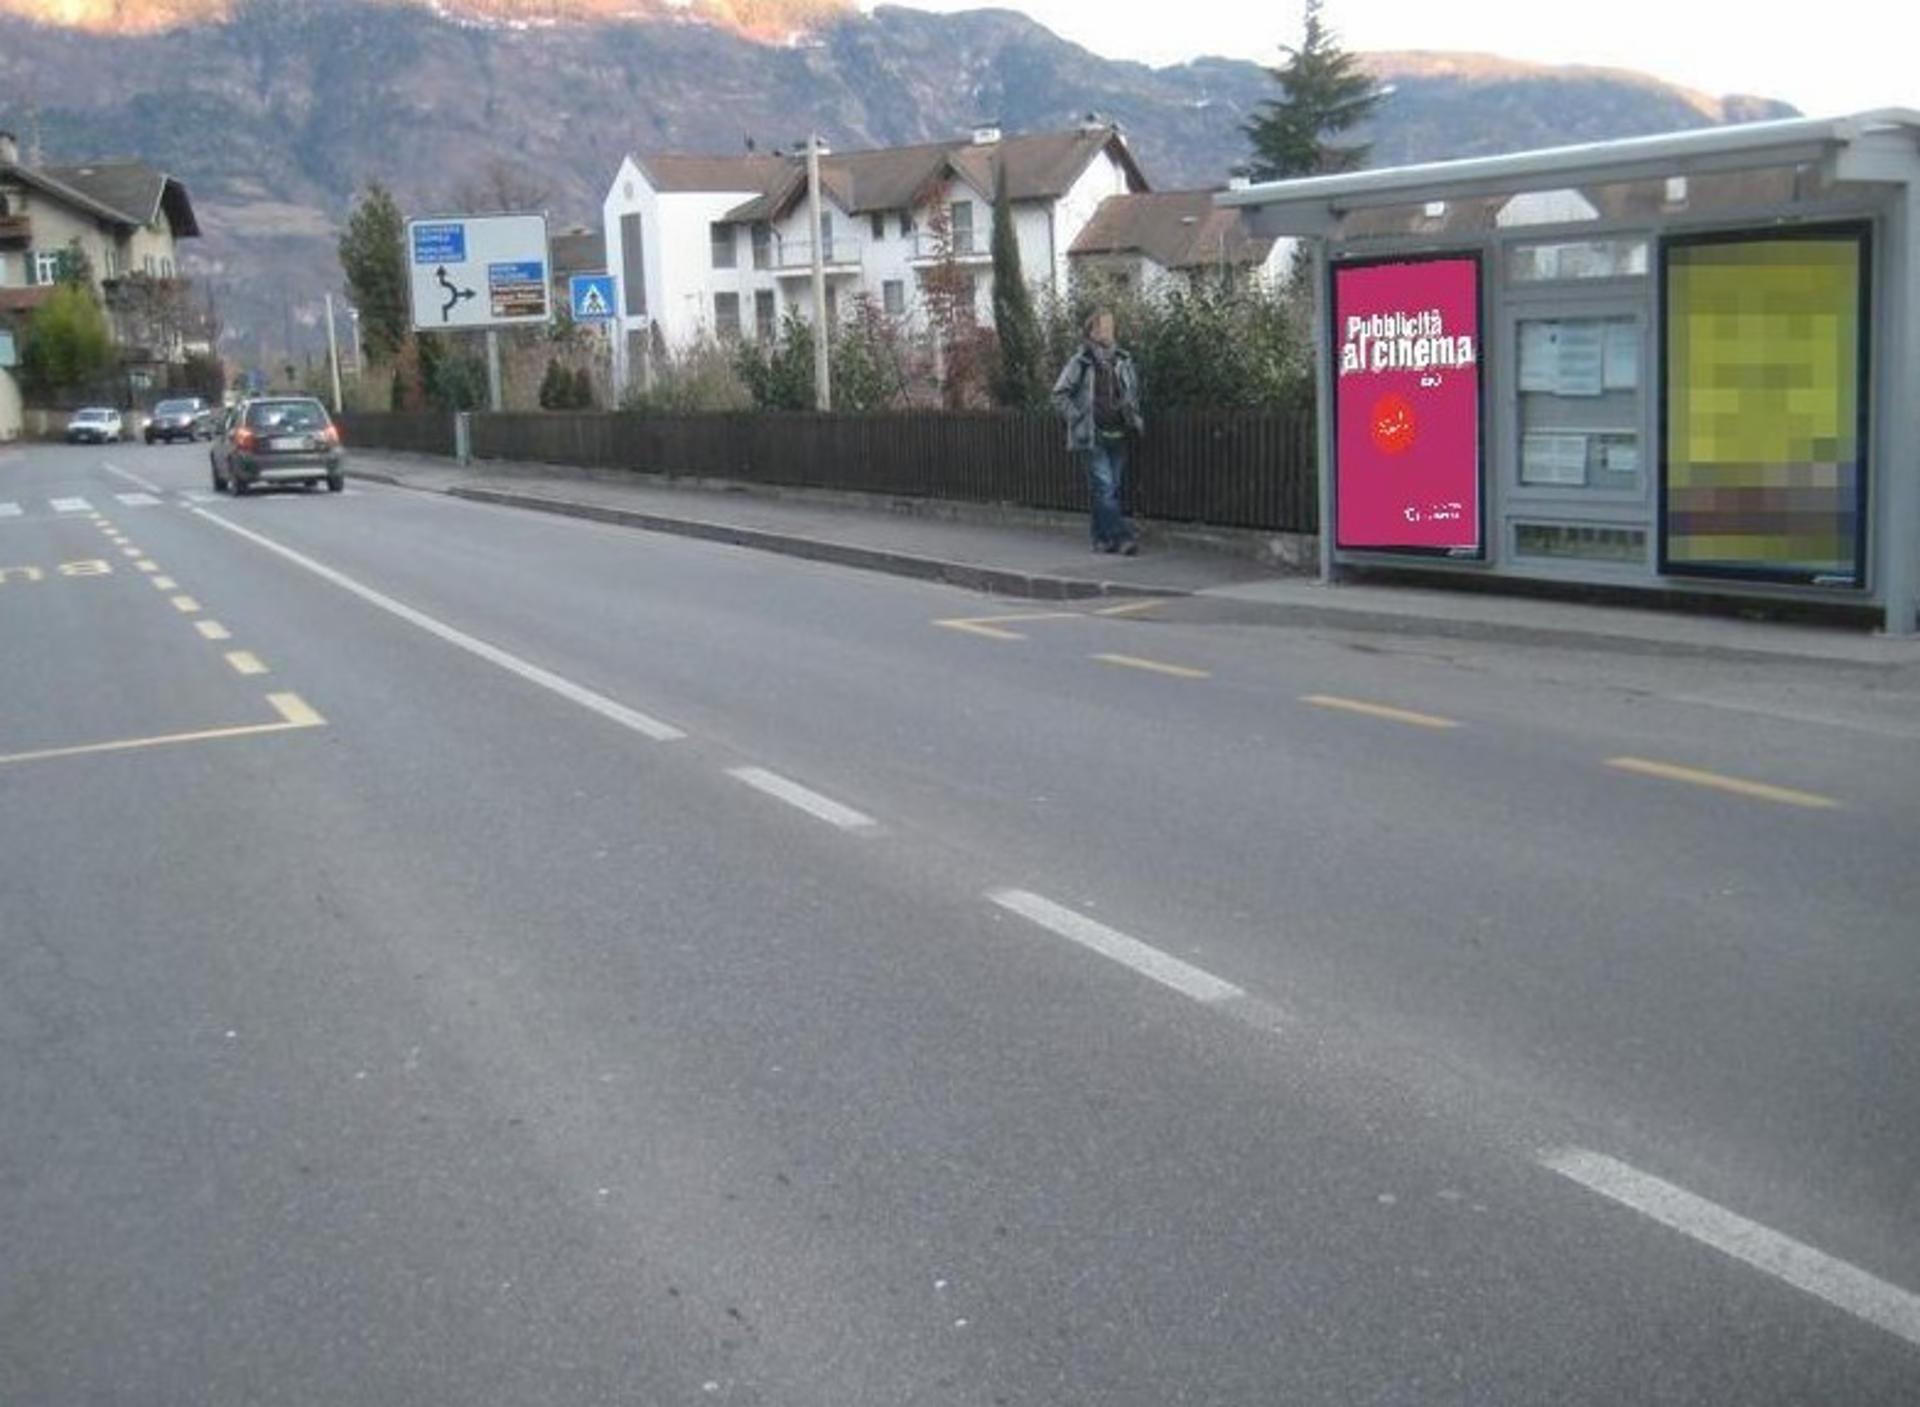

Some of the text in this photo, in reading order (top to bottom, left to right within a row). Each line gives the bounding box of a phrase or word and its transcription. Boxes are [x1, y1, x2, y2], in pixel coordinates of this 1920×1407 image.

[1346, 309, 1442, 340] Pubblicità
[1341, 335, 1474, 371] al cinema
